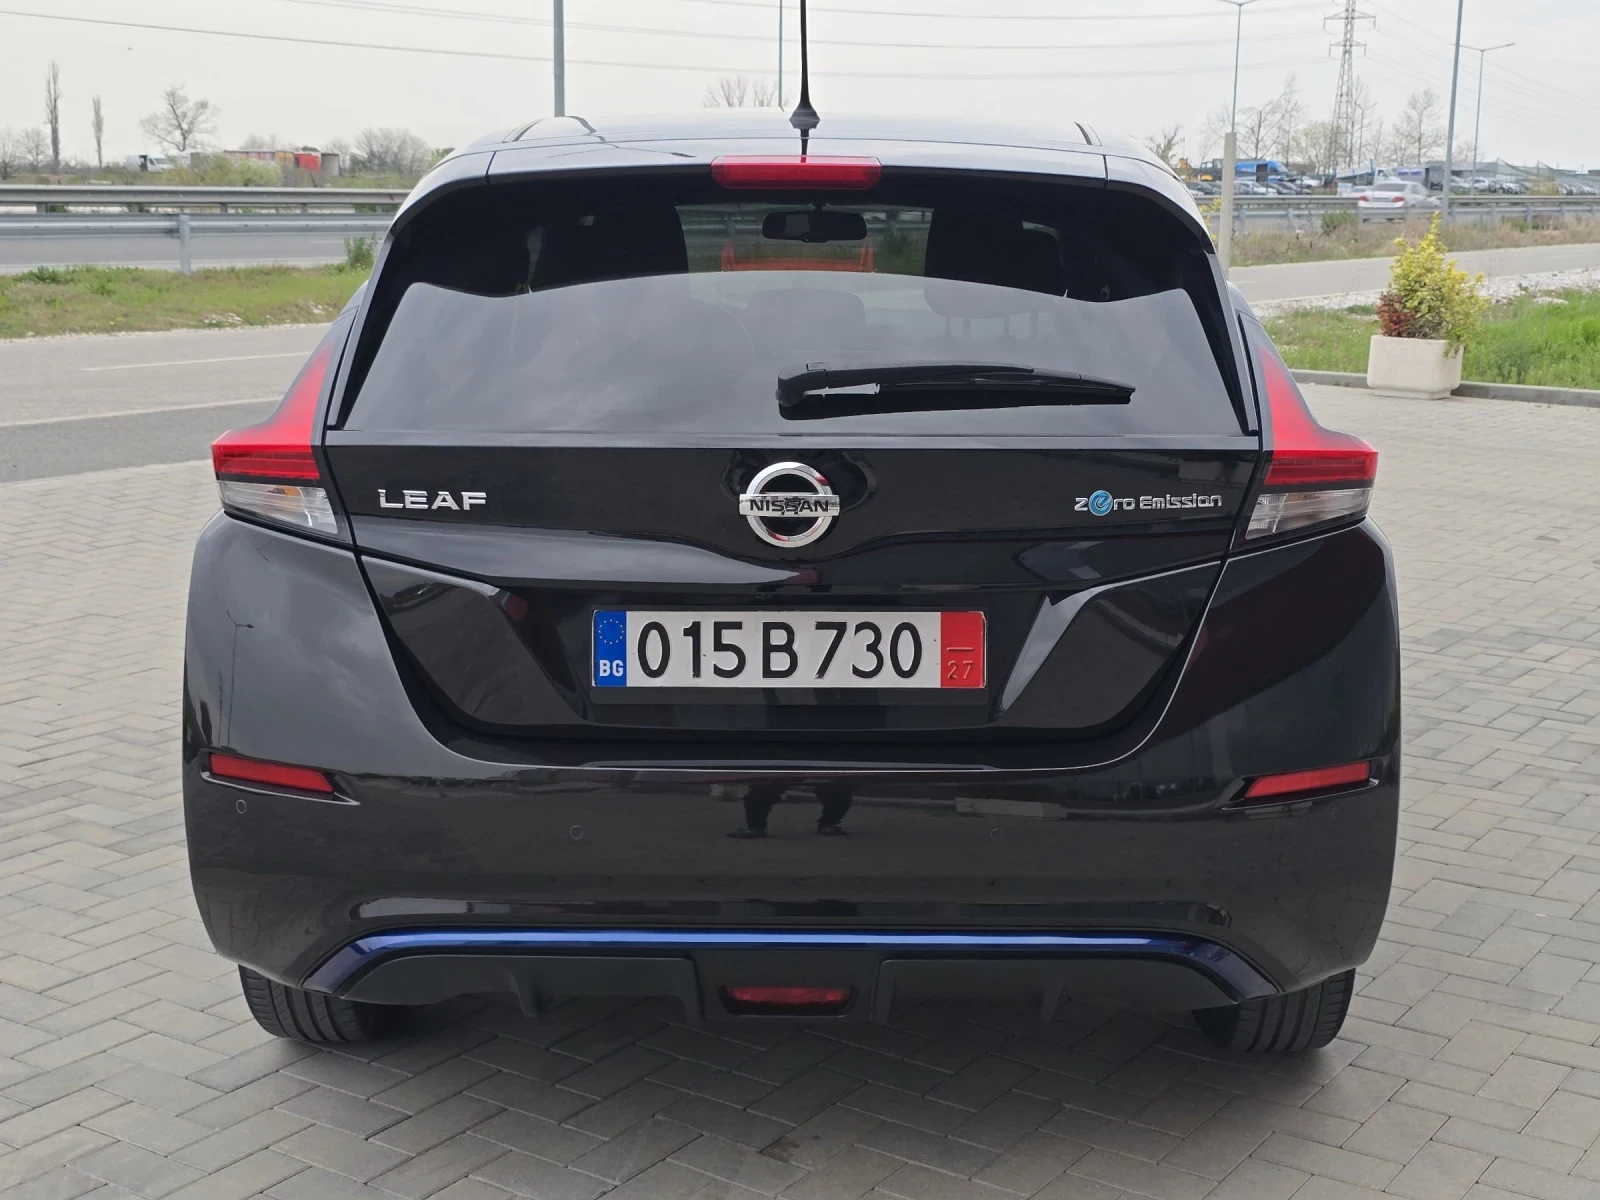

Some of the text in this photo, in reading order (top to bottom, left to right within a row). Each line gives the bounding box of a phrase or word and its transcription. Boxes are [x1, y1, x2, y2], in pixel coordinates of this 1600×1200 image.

[377, 489, 487, 510] LEAF
[749, 499, 829, 513] NISSAN
[1139, 493, 1223, 510] Emission
[599, 659, 624, 677] BG
[947, 660, 973, 679] 27
